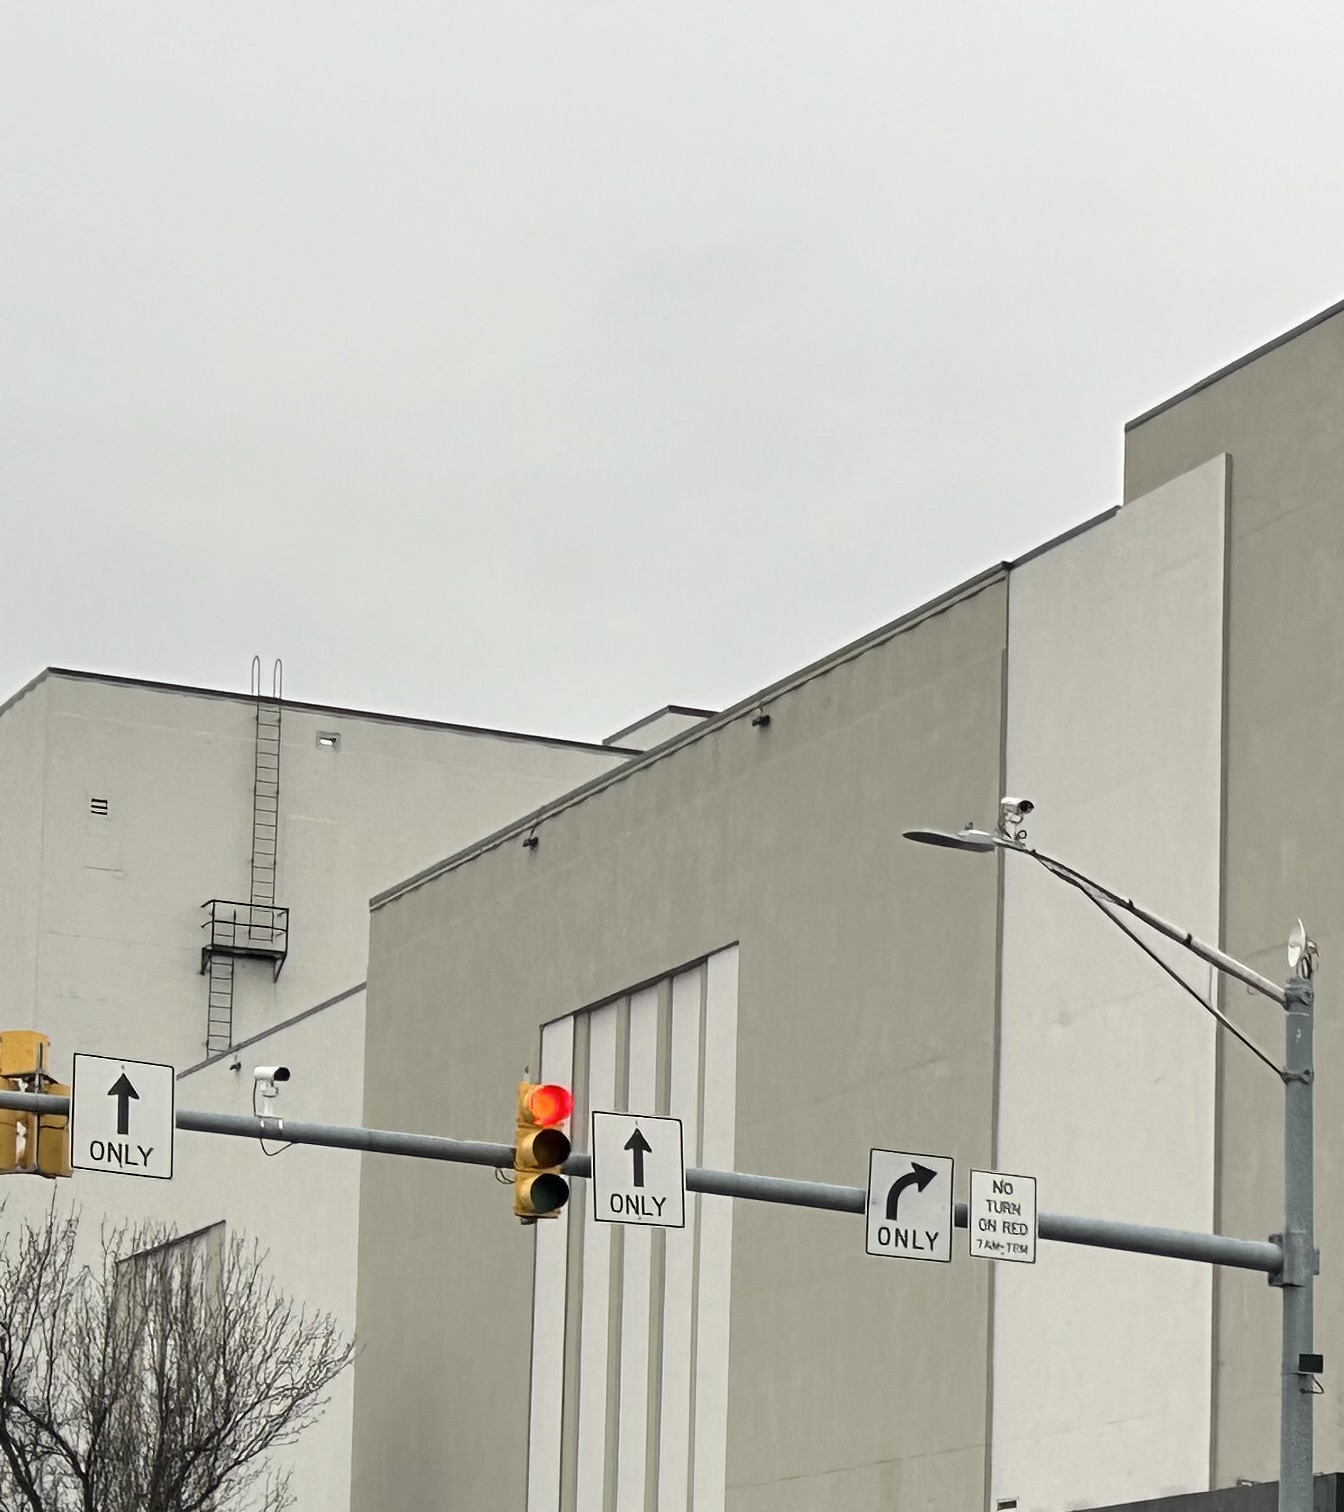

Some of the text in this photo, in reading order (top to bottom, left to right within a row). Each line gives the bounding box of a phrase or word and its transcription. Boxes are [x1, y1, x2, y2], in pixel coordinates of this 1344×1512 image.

[89, 1140, 154, 1168] ONLY
[992, 1179, 1014, 1195] NO
[610, 1193, 667, 1217] ONLY
[985, 1199, 1021, 1216] TURN
[978, 1218, 1029, 1236] ON RED
[877, 1226, 940, 1251] ONLY
